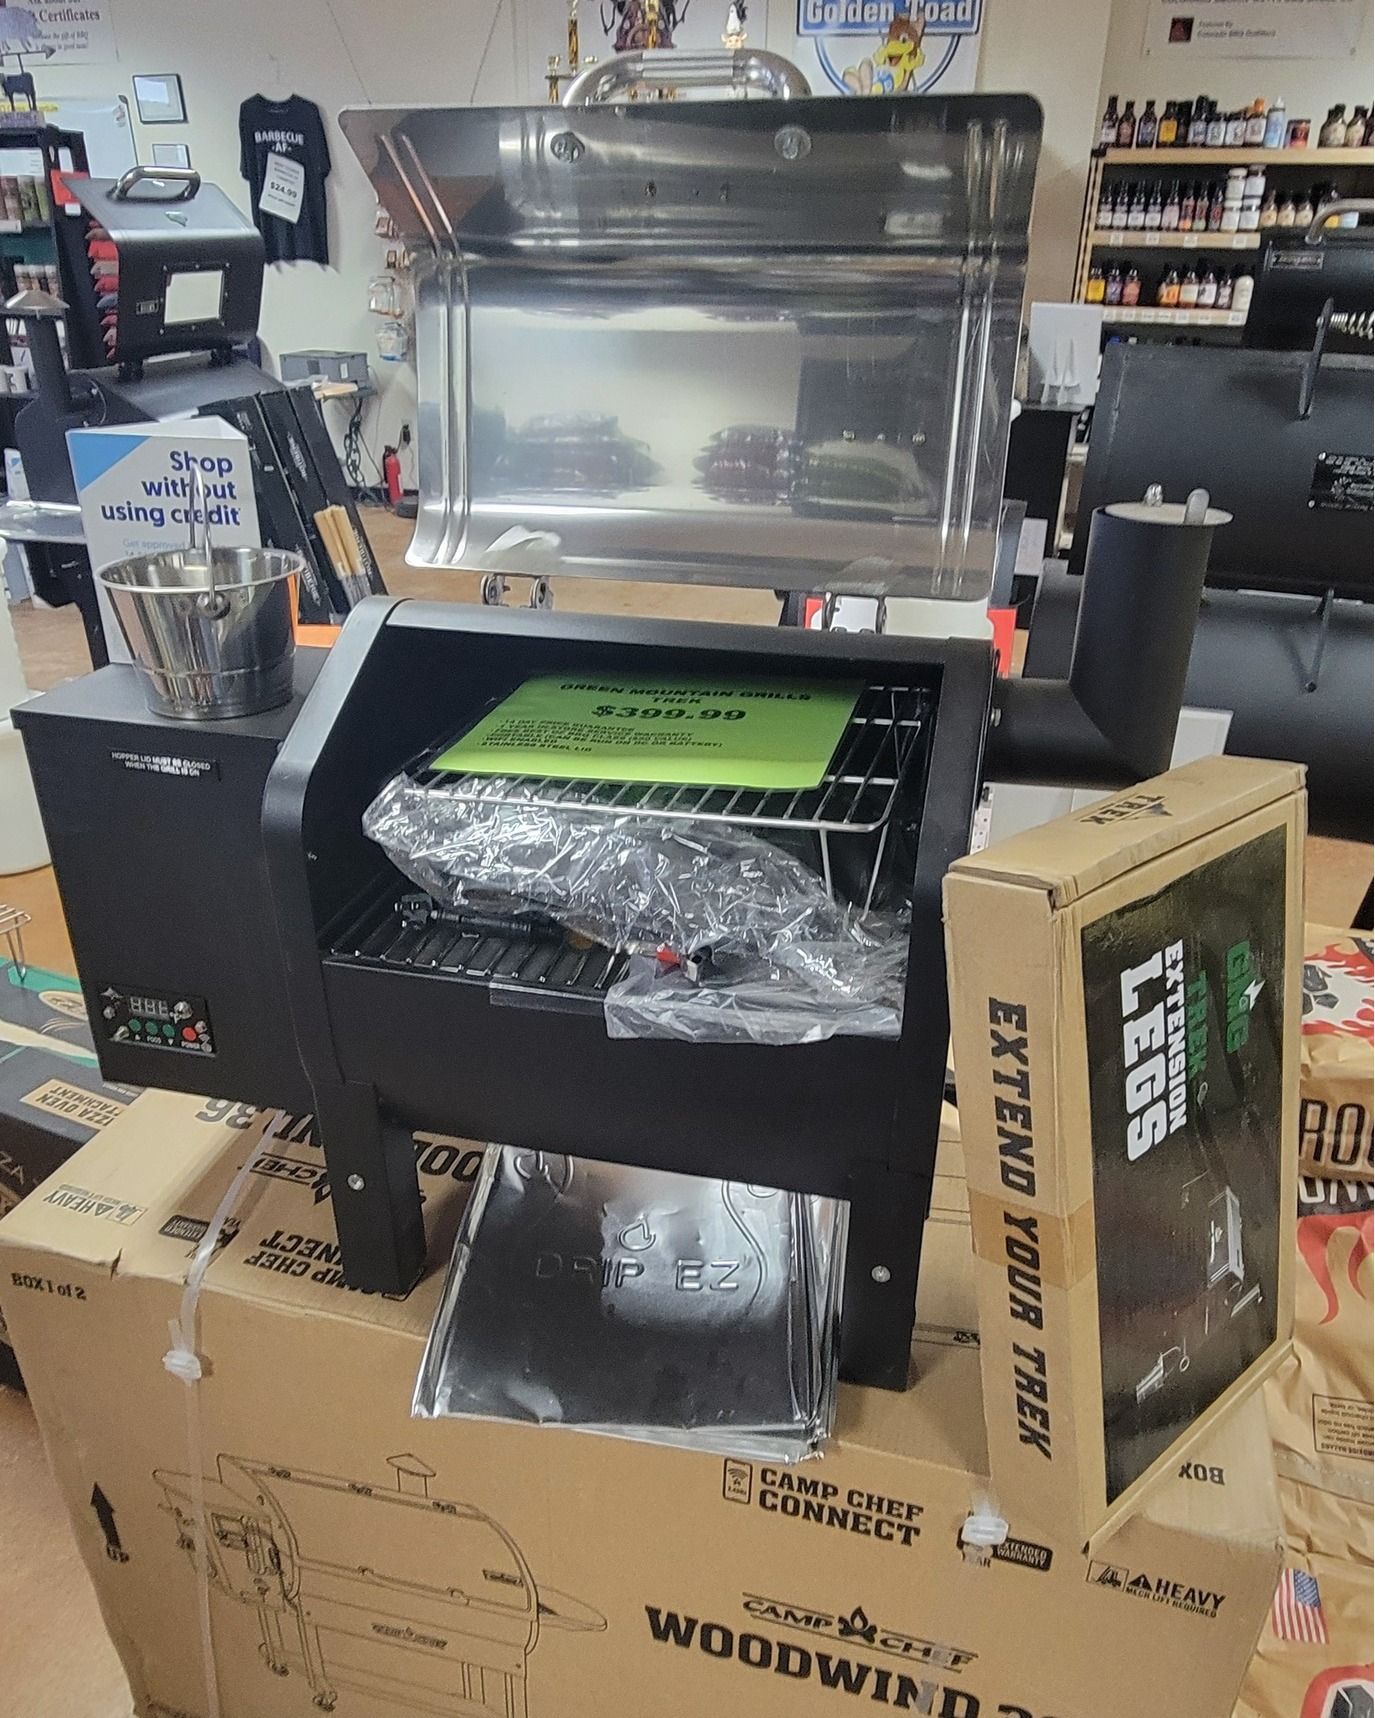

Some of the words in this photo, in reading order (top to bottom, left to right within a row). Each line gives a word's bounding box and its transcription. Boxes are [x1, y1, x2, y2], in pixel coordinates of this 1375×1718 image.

[39, 8, 100, 22] Certificates
[807, 0, 895, 24] Golden
[905, 0, 972, 22] Toad
[254, 130, 304, 146] BARBECUE
[270, 181, 297, 198] $24.99
[170, 450, 233, 477] Shop
[101, 500, 165, 527] using
[560, 683, 624, 694] GREEN
[629, 686, 734, 697] MOUNTAIN
[739, 690, 812, 701] GRILLS
[591, 704, 747, 721] $399.99
[111, 752, 139, 761] HOPPER
[140, 755, 152, 763] LID
[182, 759, 211, 771] CLOSED
[124, 760, 145, 770] WHEN
[1080, 795, 1166, 825] TREK
[1165, 938, 1187, 1135] EXTENSION
[1186, 969, 1208, 1080] TREK
[1120, 950, 1167, 1161] LEGS
[35, 1093, 79, 1113] OVEN
[50, 1086, 119, 1115] TACHMENT
[988, 996, 1036, 1198] EXTEND
[78, 1108, 115, 1127] IZZA
[43, 1190, 94, 1215] HEAVY
[260, 1230, 343, 1267] NECT
[244, 1250, 311, 1278] CHEF
[536, 1255, 646, 1289] DRIP
[676, 1259, 740, 1291] EZ
[1004, 1210, 1044, 1331] YOUR
[11, 1272, 44, 1291] BOX
[46, 1279, 54, 1294] 1
[57, 1284, 72, 1297] of
[75, 1286, 87, 1301] 2
[1012, 1341, 1052, 1461] TREK
[1178, 1462, 1225, 1486] BOX
[761, 1467, 838, 1501] CAMP
[847, 1489, 924, 1522] CHEF
[759, 1489, 921, 1547] CONNECT
[1126, 1587, 1150, 1600] MECH
[1152, 1592, 1171, 1606] LIFT
[1171, 1599, 1217, 1619] REQUIRED
[1155, 1577, 1227, 1611] HEAVY
[742, 1599, 833, 1629] CAMP
[645, 1605, 982, 1718] WOODWIND
